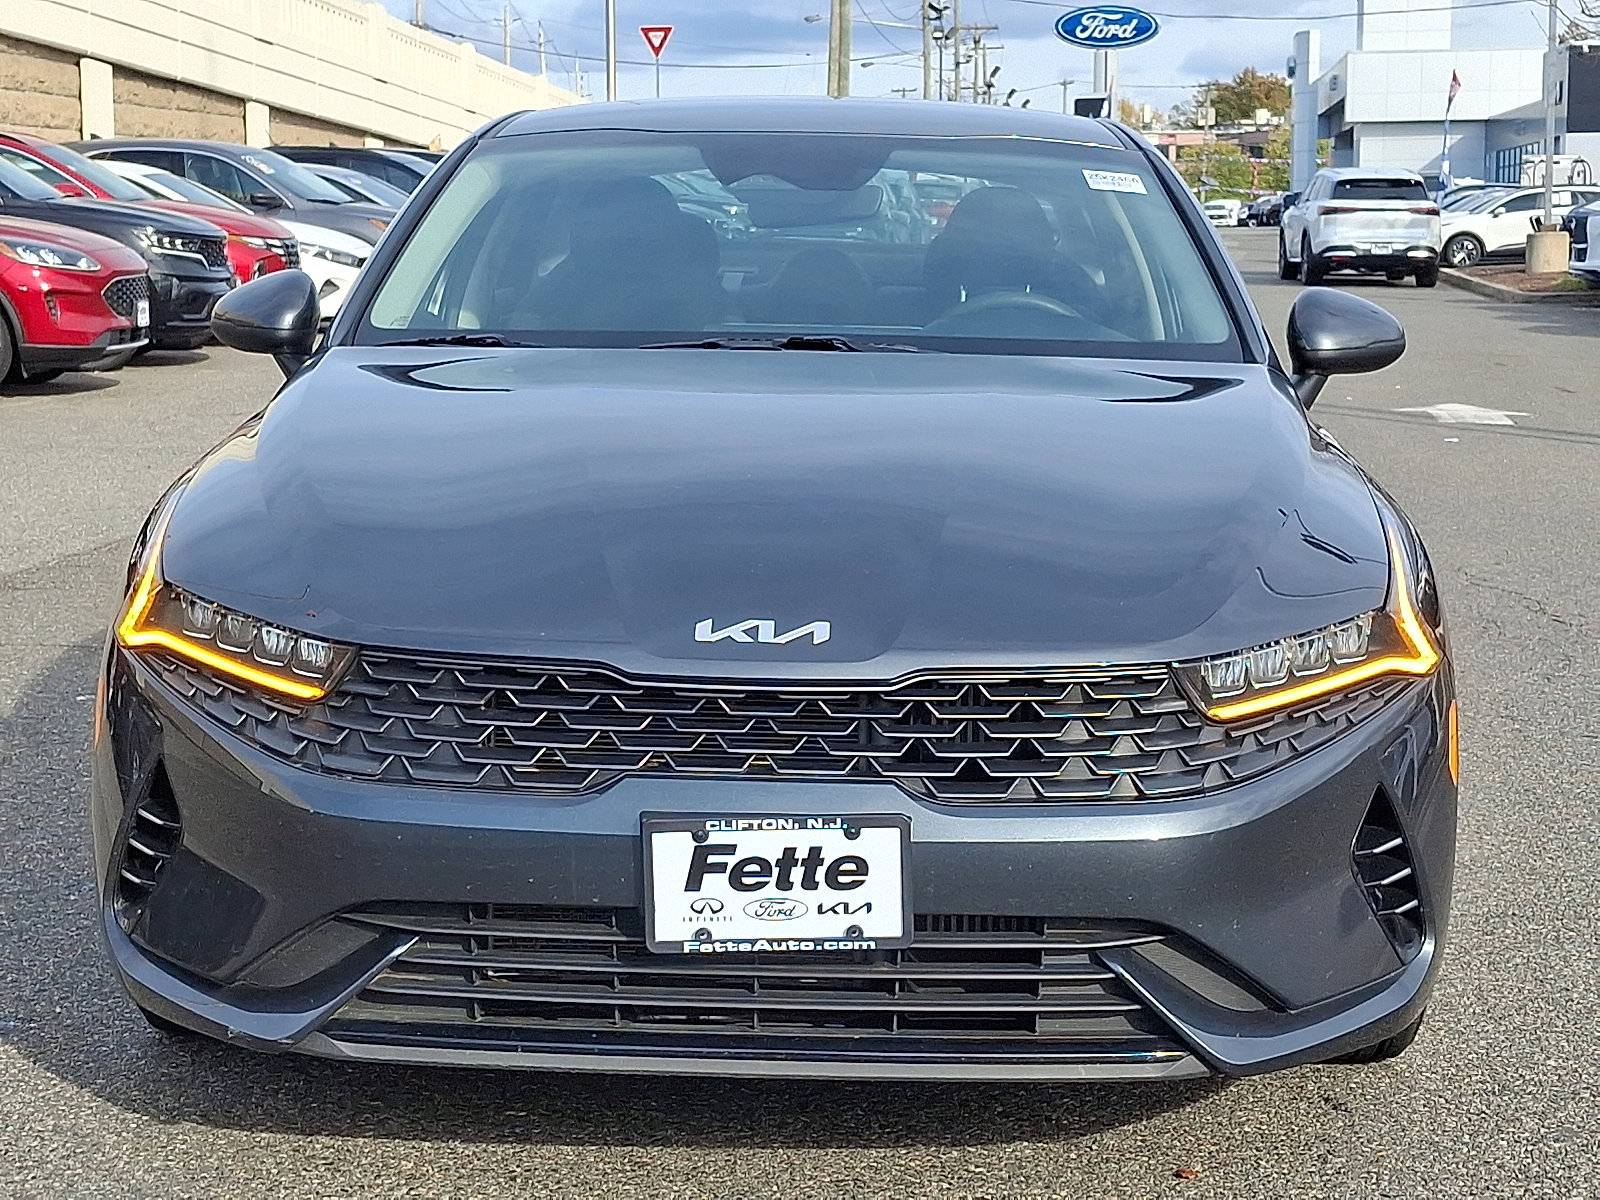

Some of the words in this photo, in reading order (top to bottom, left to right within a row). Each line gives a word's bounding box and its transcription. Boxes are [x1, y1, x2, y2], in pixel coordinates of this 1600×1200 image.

[1075, 12, 1138, 39] Ford
[694, 617, 831, 645] KIA
[705, 819, 799, 830] CLIFTON,
[806, 817, 849, 830] N.J.
[684, 843, 869, 892] Fette
[754, 900, 797, 918] Ford
[817, 901, 872, 915] KIA
[683, 939, 876, 954] FetteAuto.com
